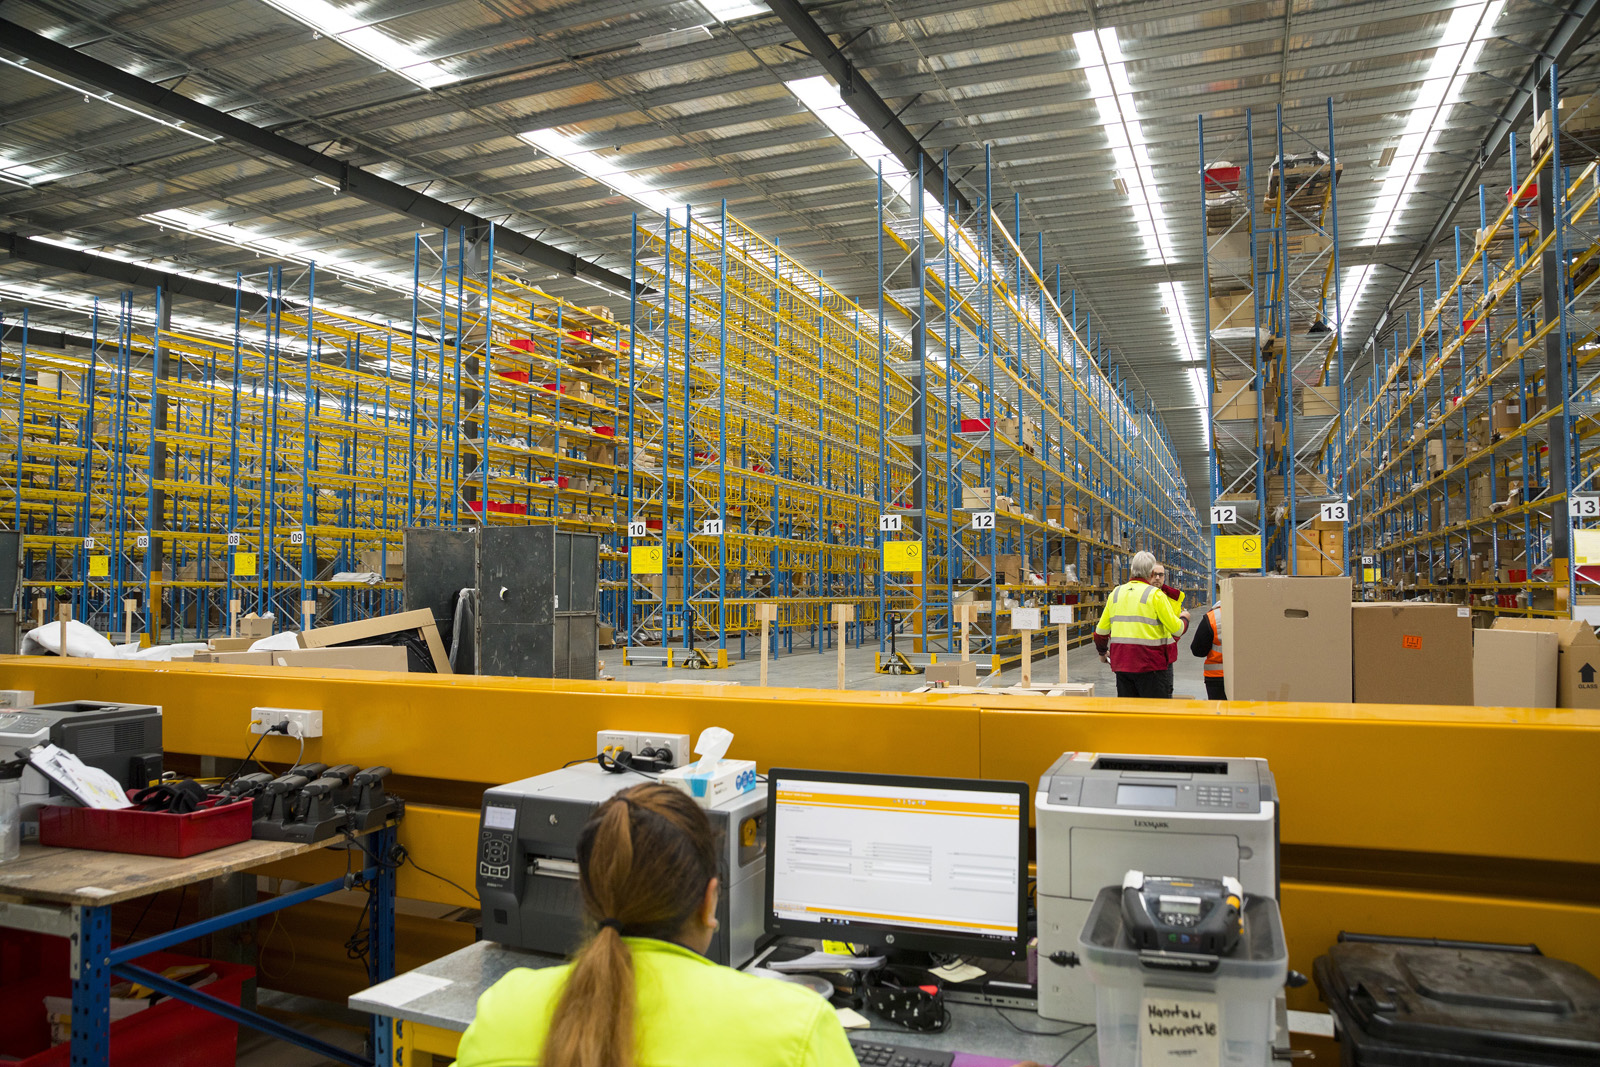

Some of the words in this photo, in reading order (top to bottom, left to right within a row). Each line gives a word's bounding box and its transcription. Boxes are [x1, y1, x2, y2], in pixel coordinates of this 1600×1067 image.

[1324, 506, 1345, 519] 13
[1572, 500, 1596, 514] 13
[975, 515, 992, 527] 12
[1213, 509, 1234, 522] 12
[706, 522, 720, 533] 11
[882, 517, 898, 529] 11
[630, 524, 644, 535] 10
[229, 535, 239, 544] 08
[292, 533, 303, 543] 09
[85, 540, 93, 548] 07
[1133, 819, 1169, 829] LEXMARK
